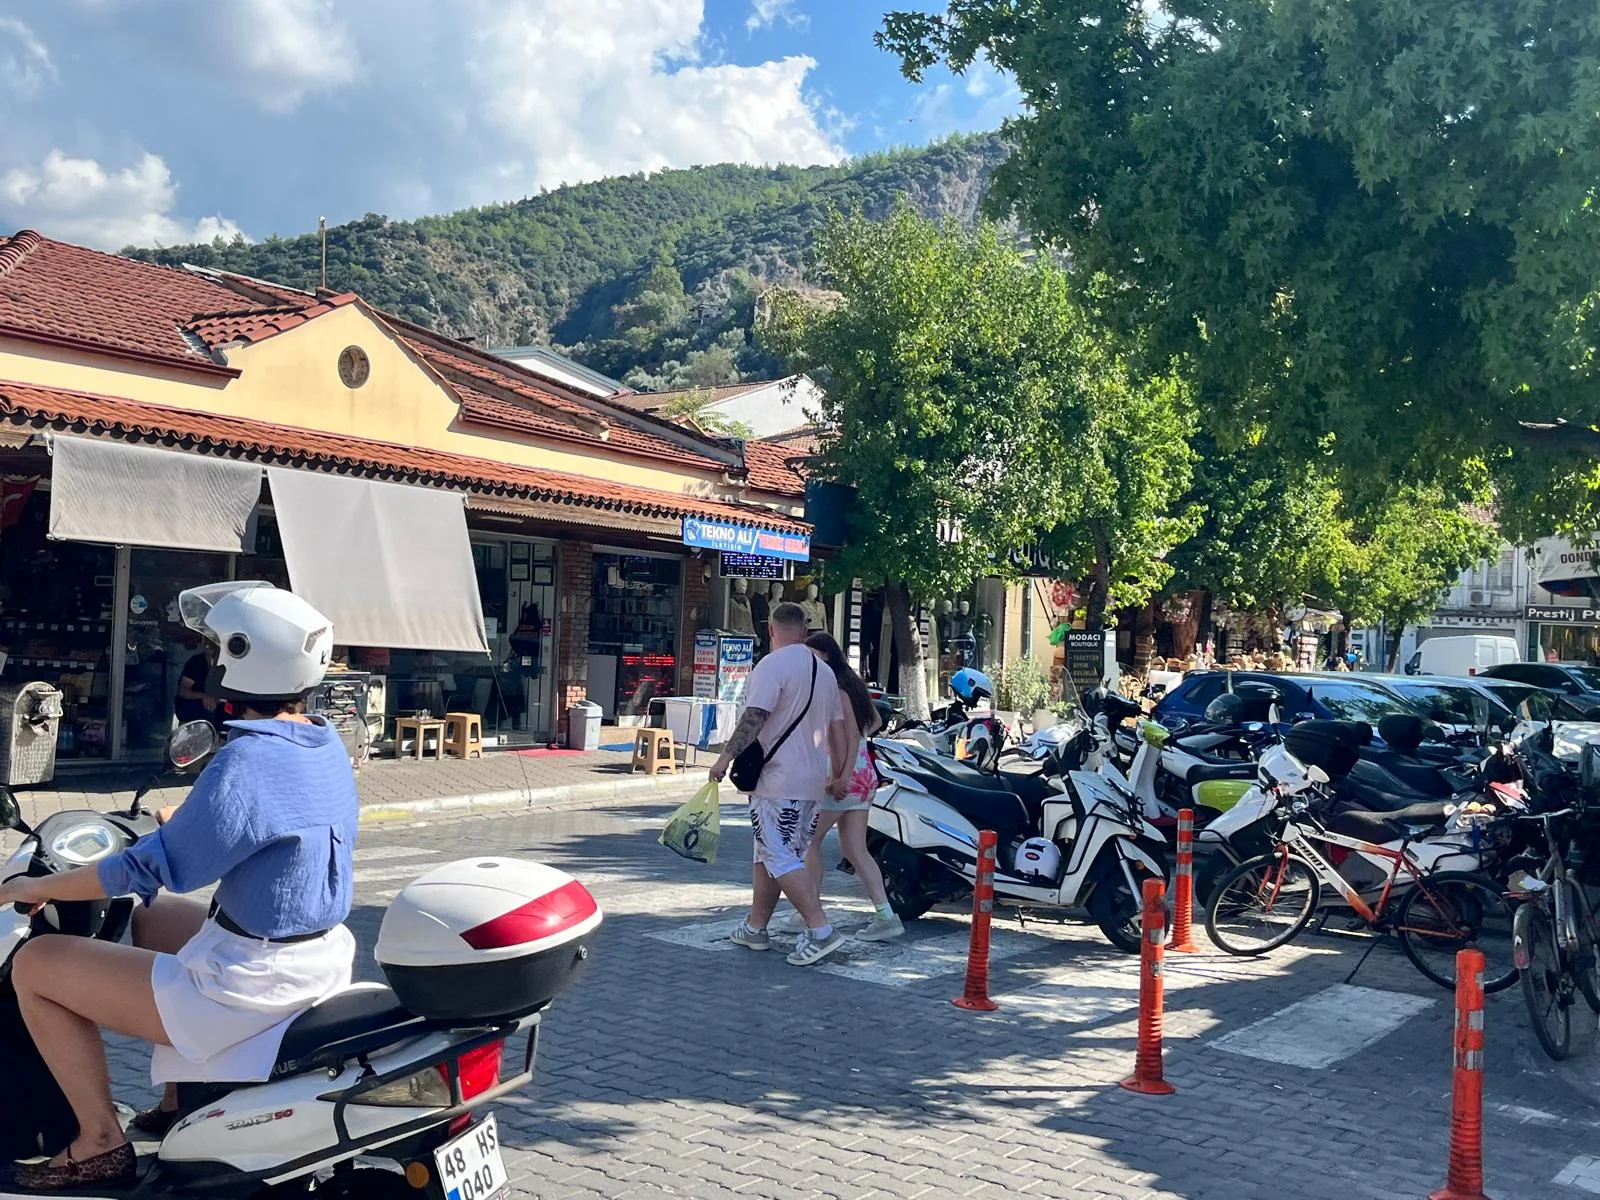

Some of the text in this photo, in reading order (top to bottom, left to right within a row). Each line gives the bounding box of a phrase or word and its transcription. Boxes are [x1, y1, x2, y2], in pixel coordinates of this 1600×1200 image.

[700, 524, 753, 545] TEKNO ALİ
[1528, 608, 1575, 621] Prestij
[445, 1124, 496, 1179] 48 HS
[462, 1164, 493, 1200] 040
